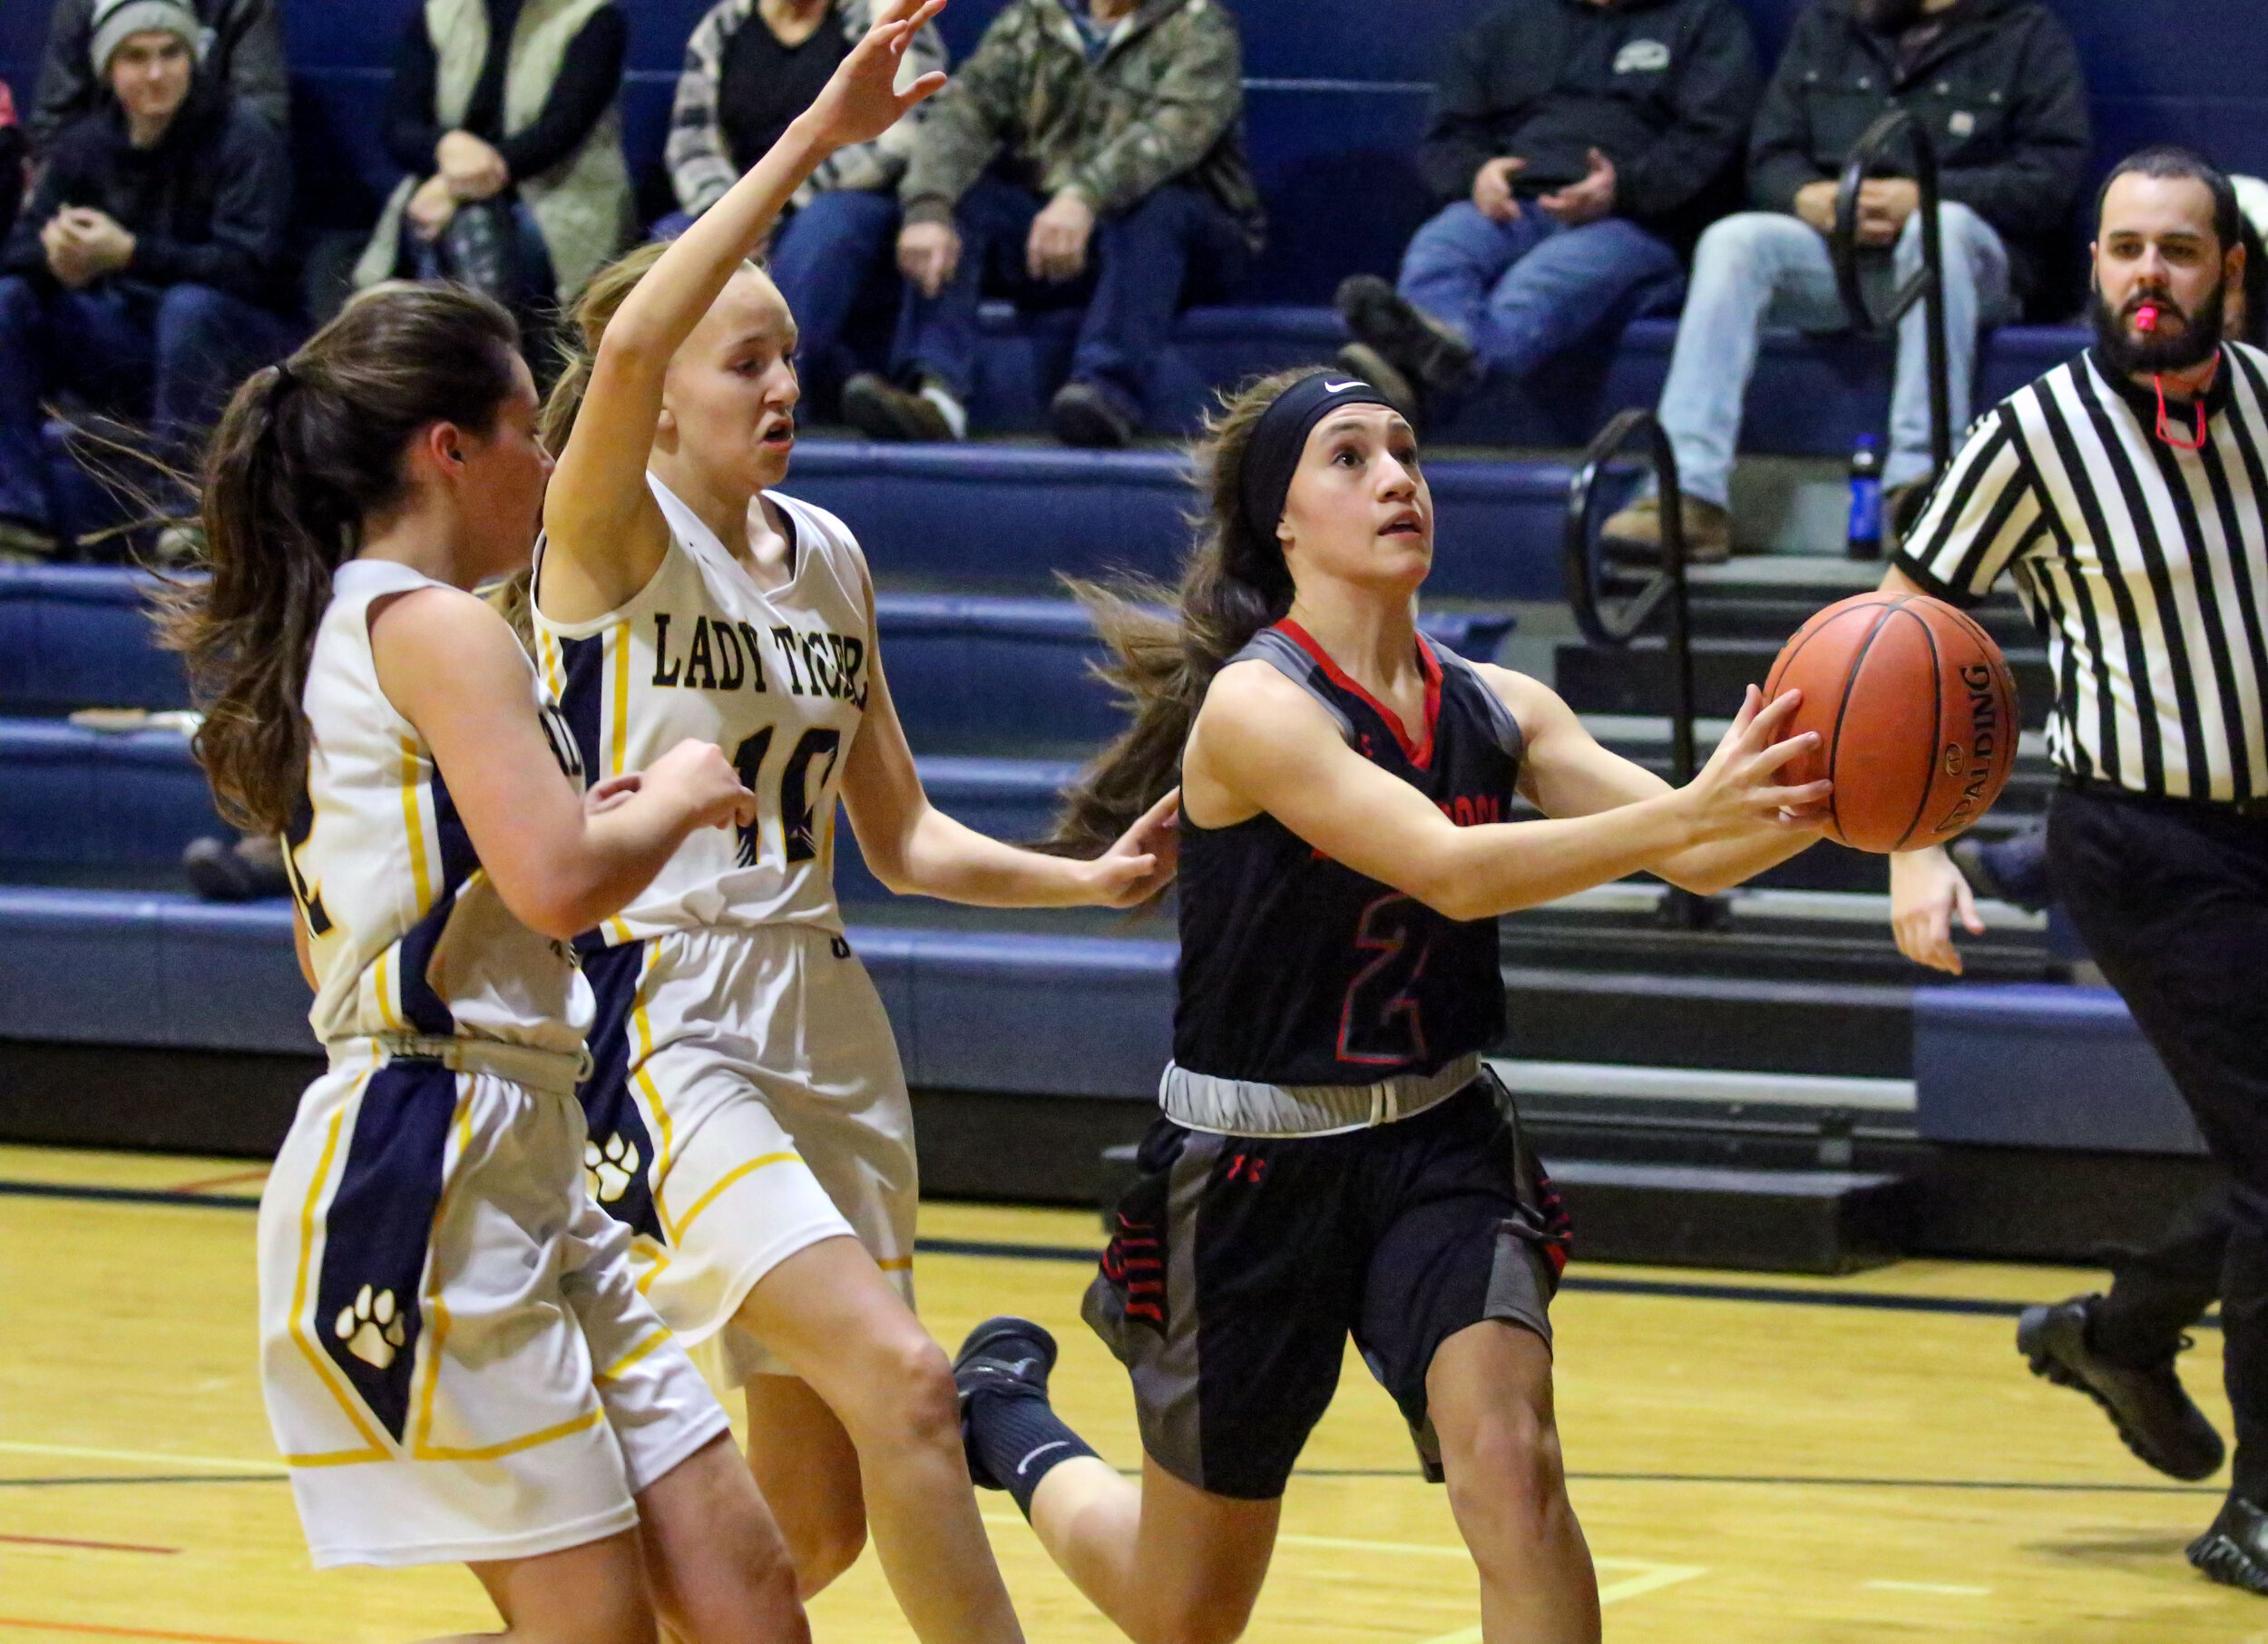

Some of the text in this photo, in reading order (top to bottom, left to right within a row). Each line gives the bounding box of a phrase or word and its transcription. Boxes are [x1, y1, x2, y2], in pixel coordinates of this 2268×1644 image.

[652, 613, 767, 692] LADY
[733, 725, 841, 868] 10
[1336, 892, 1429, 1064] 2
